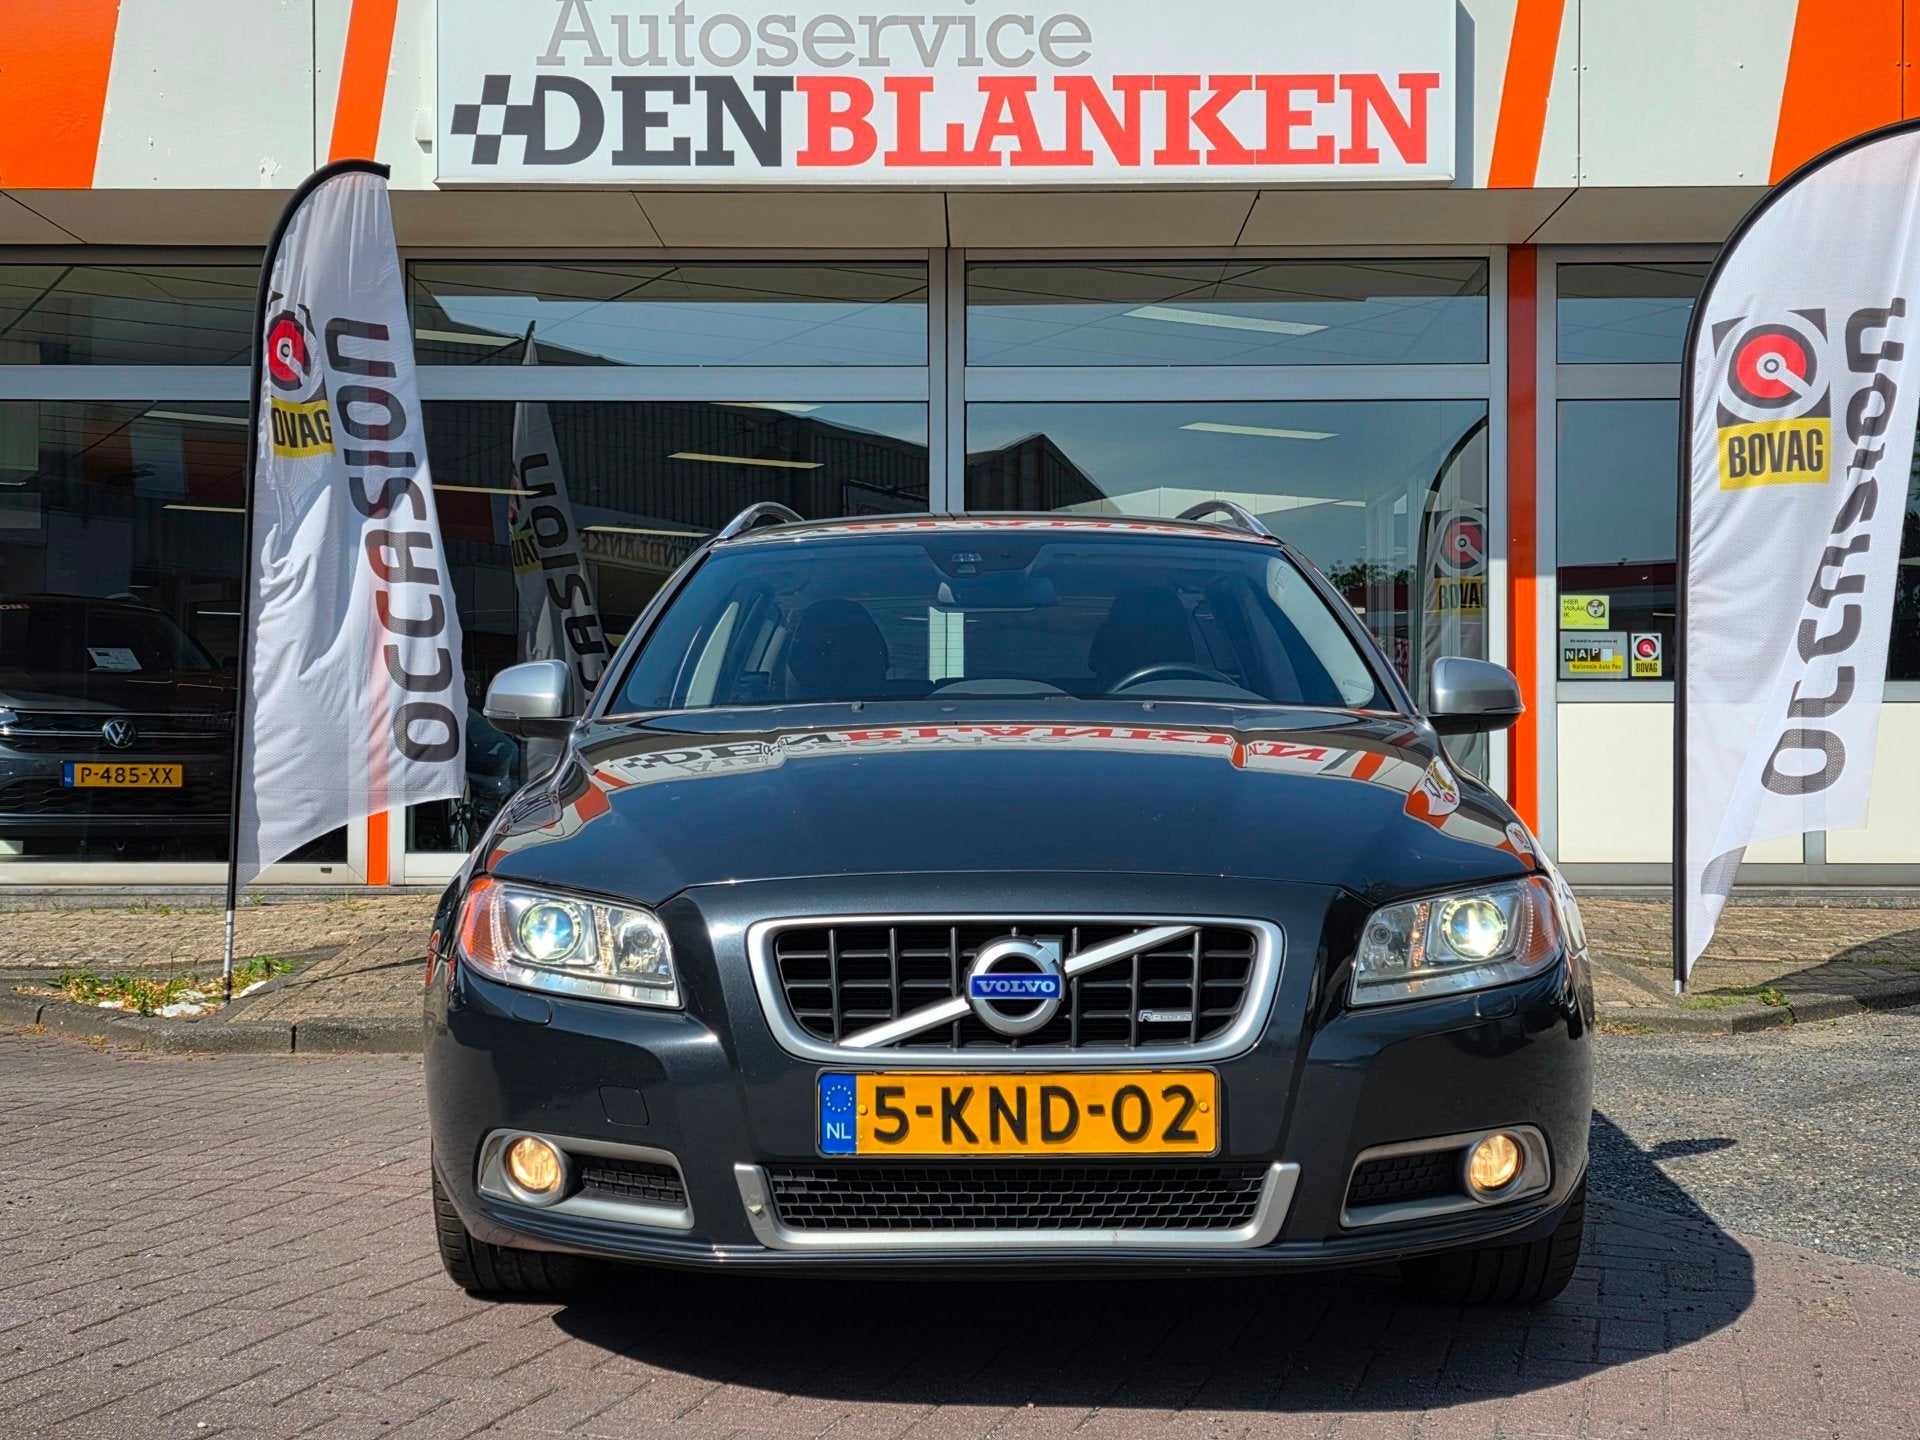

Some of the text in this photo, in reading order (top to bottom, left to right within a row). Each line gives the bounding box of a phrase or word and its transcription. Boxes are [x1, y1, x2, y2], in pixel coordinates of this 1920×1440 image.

[535, 0, 1093, 68] Autoservice
[271, 407, 333, 449] OVAG
[1728, 428, 1824, 479] BOVAG
[1565, 647, 1600, 660] NAP
[1635, 662, 1658, 673] BOVAG
[80, 767, 173, 784] P-485-XX
[976, 979, 1057, 994] VOLVO
[826, 1084, 1200, 1145] NL 5-KND-02
